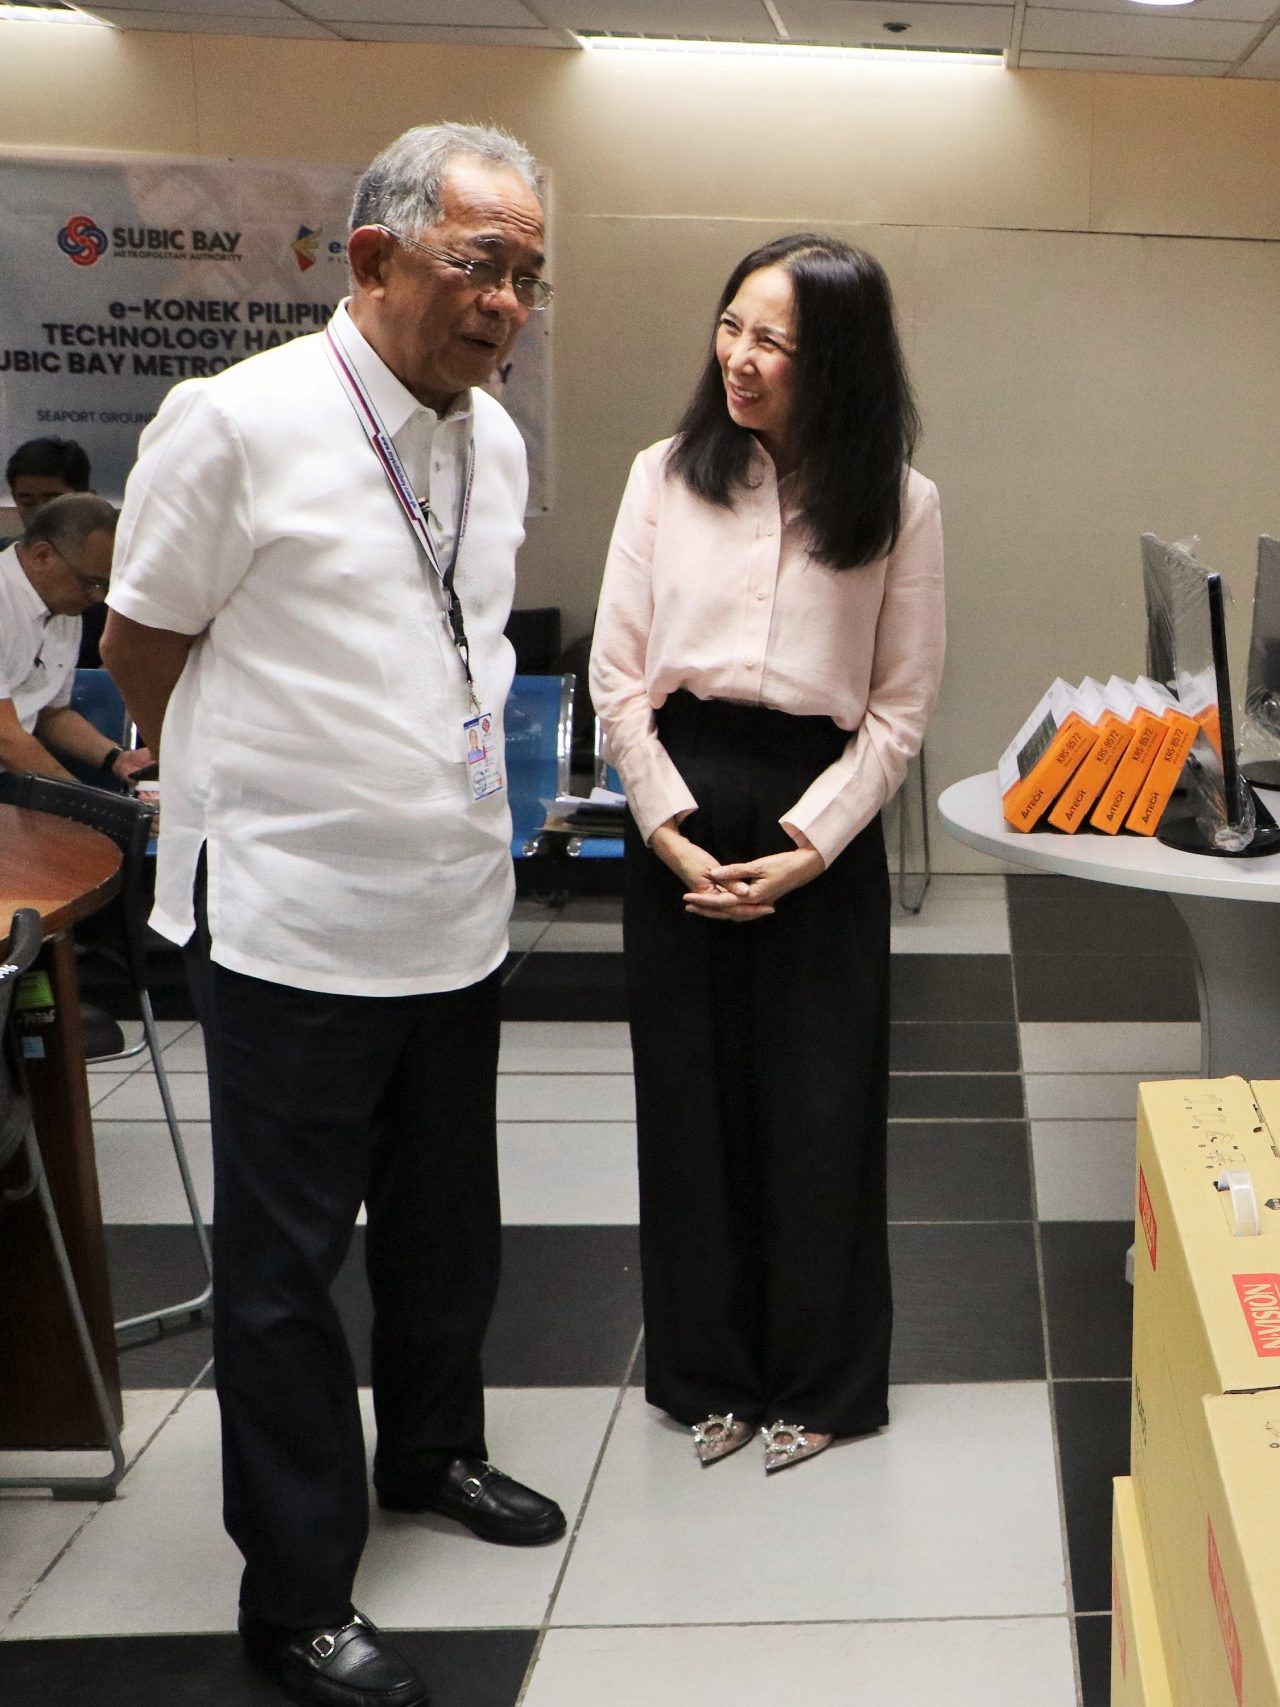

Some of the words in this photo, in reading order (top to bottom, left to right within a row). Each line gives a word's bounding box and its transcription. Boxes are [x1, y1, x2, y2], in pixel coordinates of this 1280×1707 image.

[113, 227, 184, 250] SUBIC
[192, 230, 242, 252] BAY
[113, 250, 187, 260] METROPOLITAN
[189, 252, 242, 262] AUTHORITY
[109, 300, 241, 323] e-KONEK
[249, 302, 337, 325] PILIPIN
[42, 323, 237, 350] TECHNOLOGY
[0, 350, 61, 373] UBIC
[69, 353, 125, 375] BAY
[133, 354, 244, 377] METRO
[36, 410, 96, 422] SEAPORT
